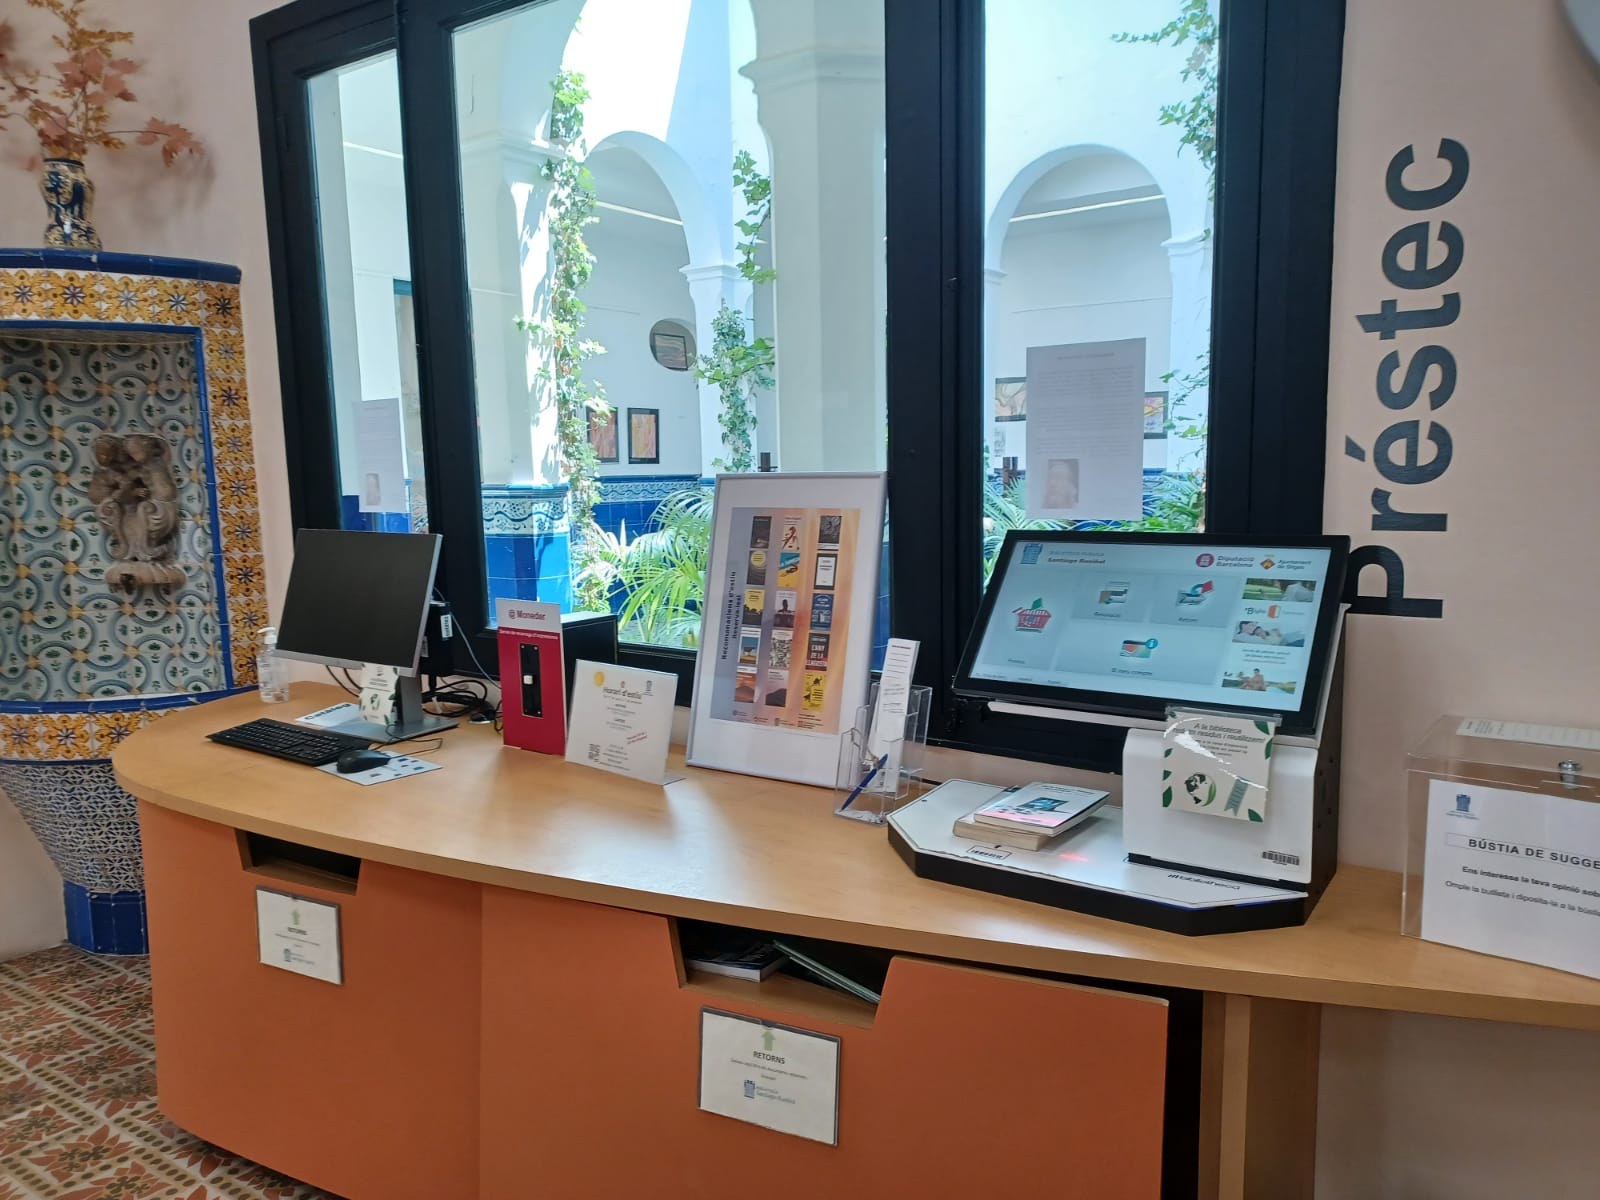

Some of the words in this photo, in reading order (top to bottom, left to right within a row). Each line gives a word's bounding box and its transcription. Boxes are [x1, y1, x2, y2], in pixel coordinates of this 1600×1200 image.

[1345, 137, 1471, 619] Préstec
[1468, 838, 1519, 854] BÚSTIA
[1525, 847, 1544, 859] DE
[1550, 852, 1600, 870] SUGGE
[1462, 865, 1478, 875] Ens
[1480, 869, 1519, 882] interessa
[1521, 875, 1530, 883] la
[1531, 878, 1550, 887] teva
[1551, 882, 1580, 894] opinió
[753, 1050, 786, 1065] RETORNS
